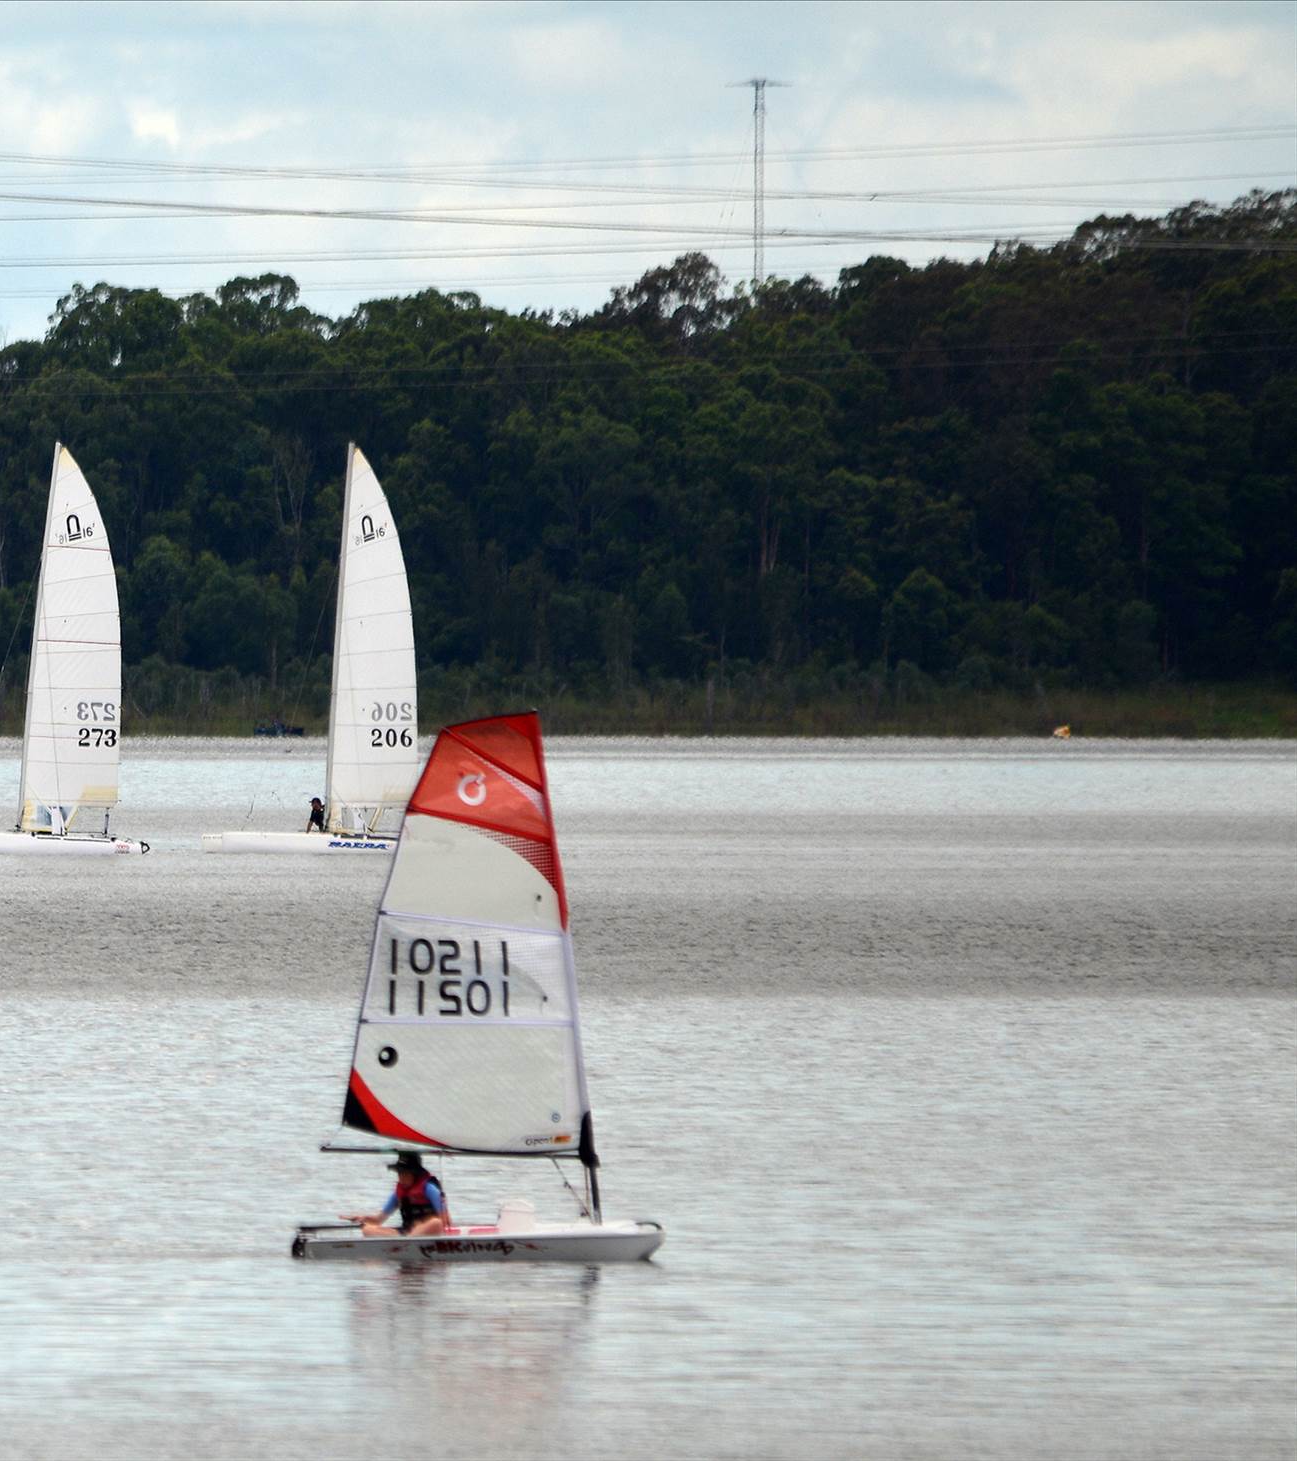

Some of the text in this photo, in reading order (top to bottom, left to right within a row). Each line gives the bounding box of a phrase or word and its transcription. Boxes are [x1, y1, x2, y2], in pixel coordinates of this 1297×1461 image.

[78, 728, 117, 748] 273
[371, 728, 413, 748] 206
[391, 938, 510, 976] 10211
